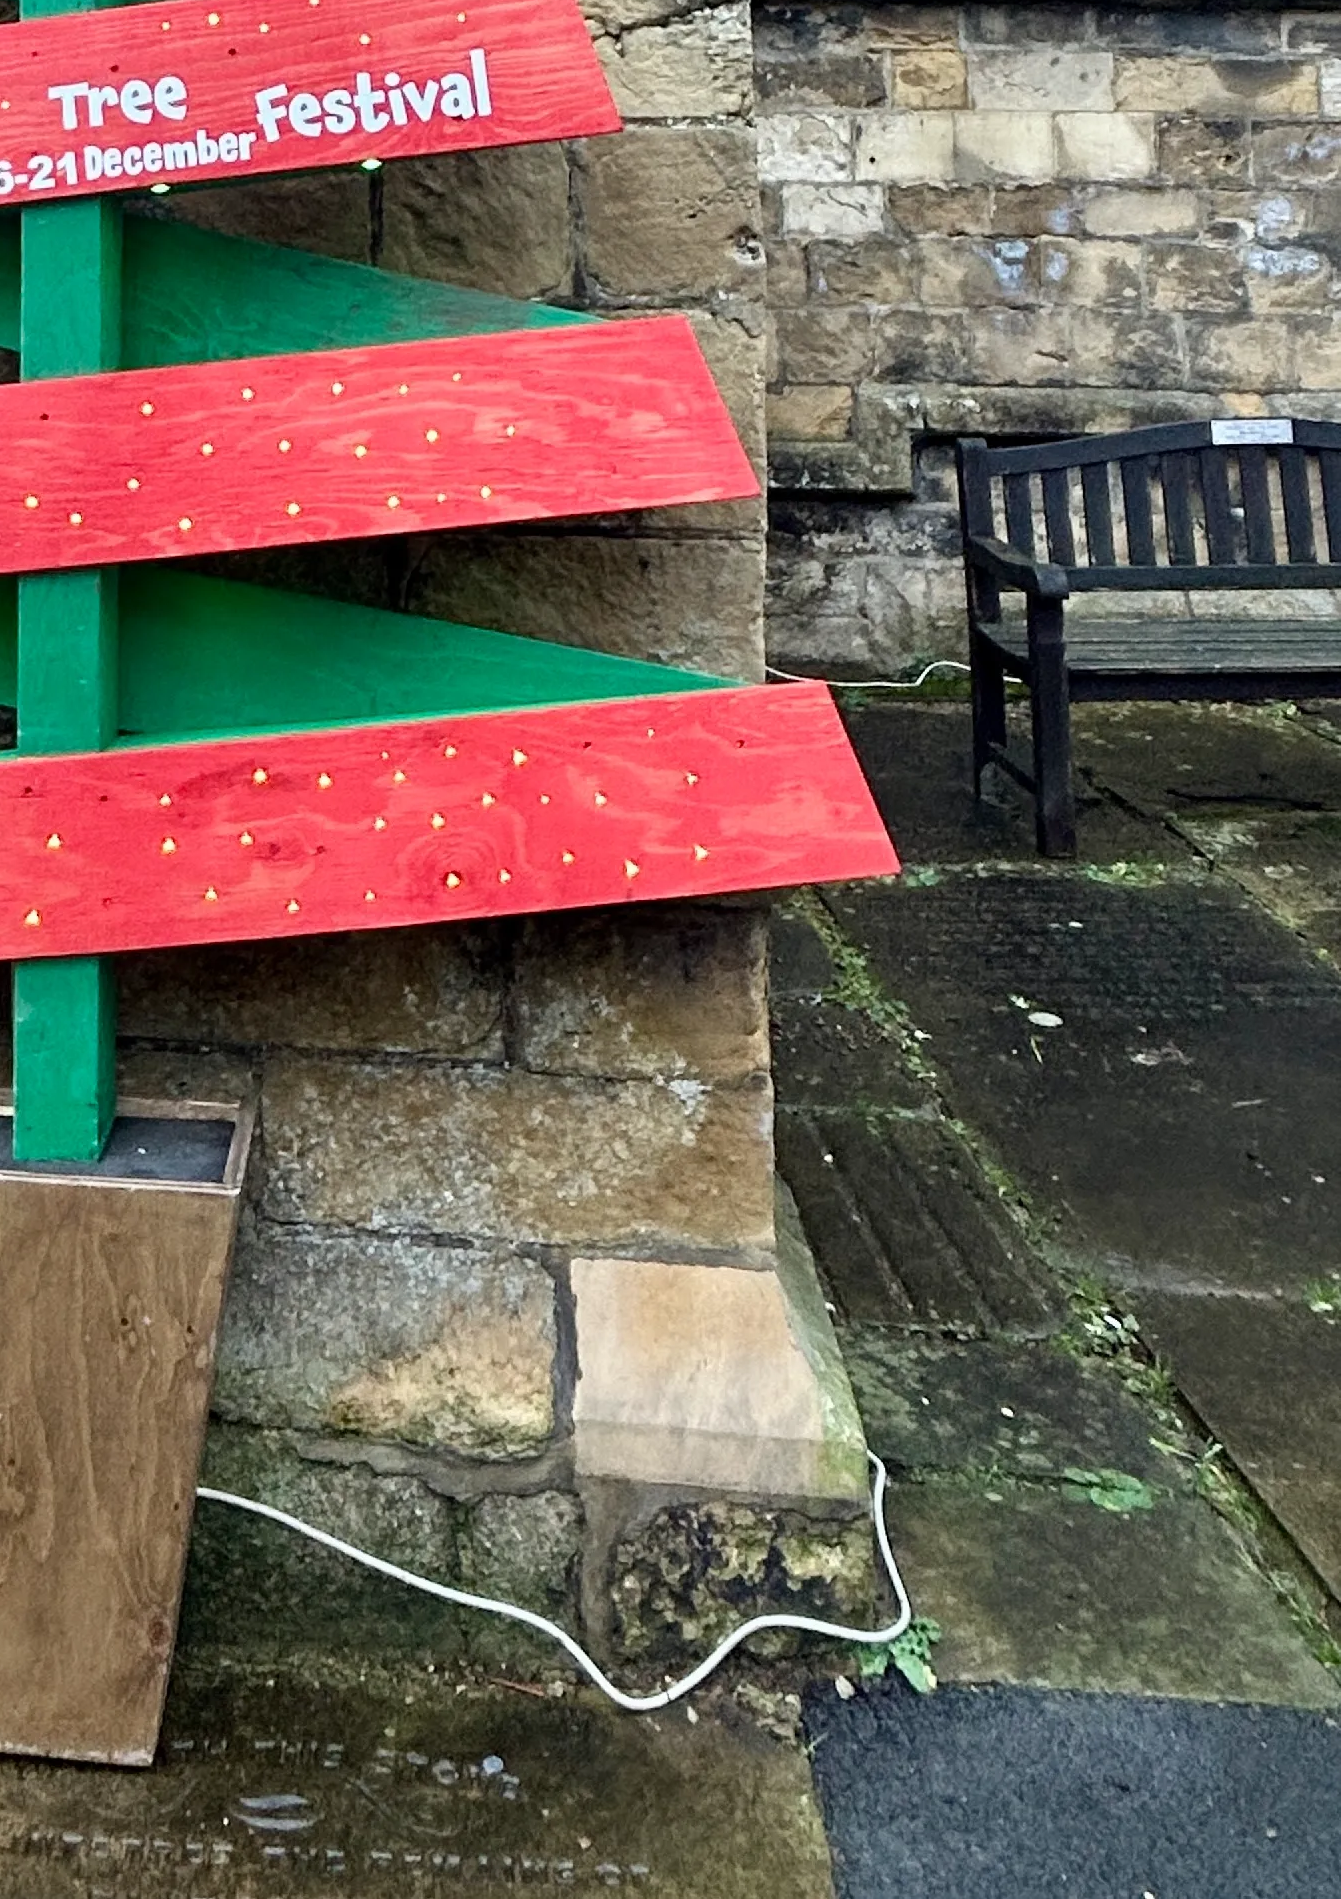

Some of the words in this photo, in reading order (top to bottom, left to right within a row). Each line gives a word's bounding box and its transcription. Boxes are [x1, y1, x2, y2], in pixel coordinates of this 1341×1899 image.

[48, 76, 187, 131] Tree
[255, 48, 492, 143] Festival
[84, 130, 257, 183] December
